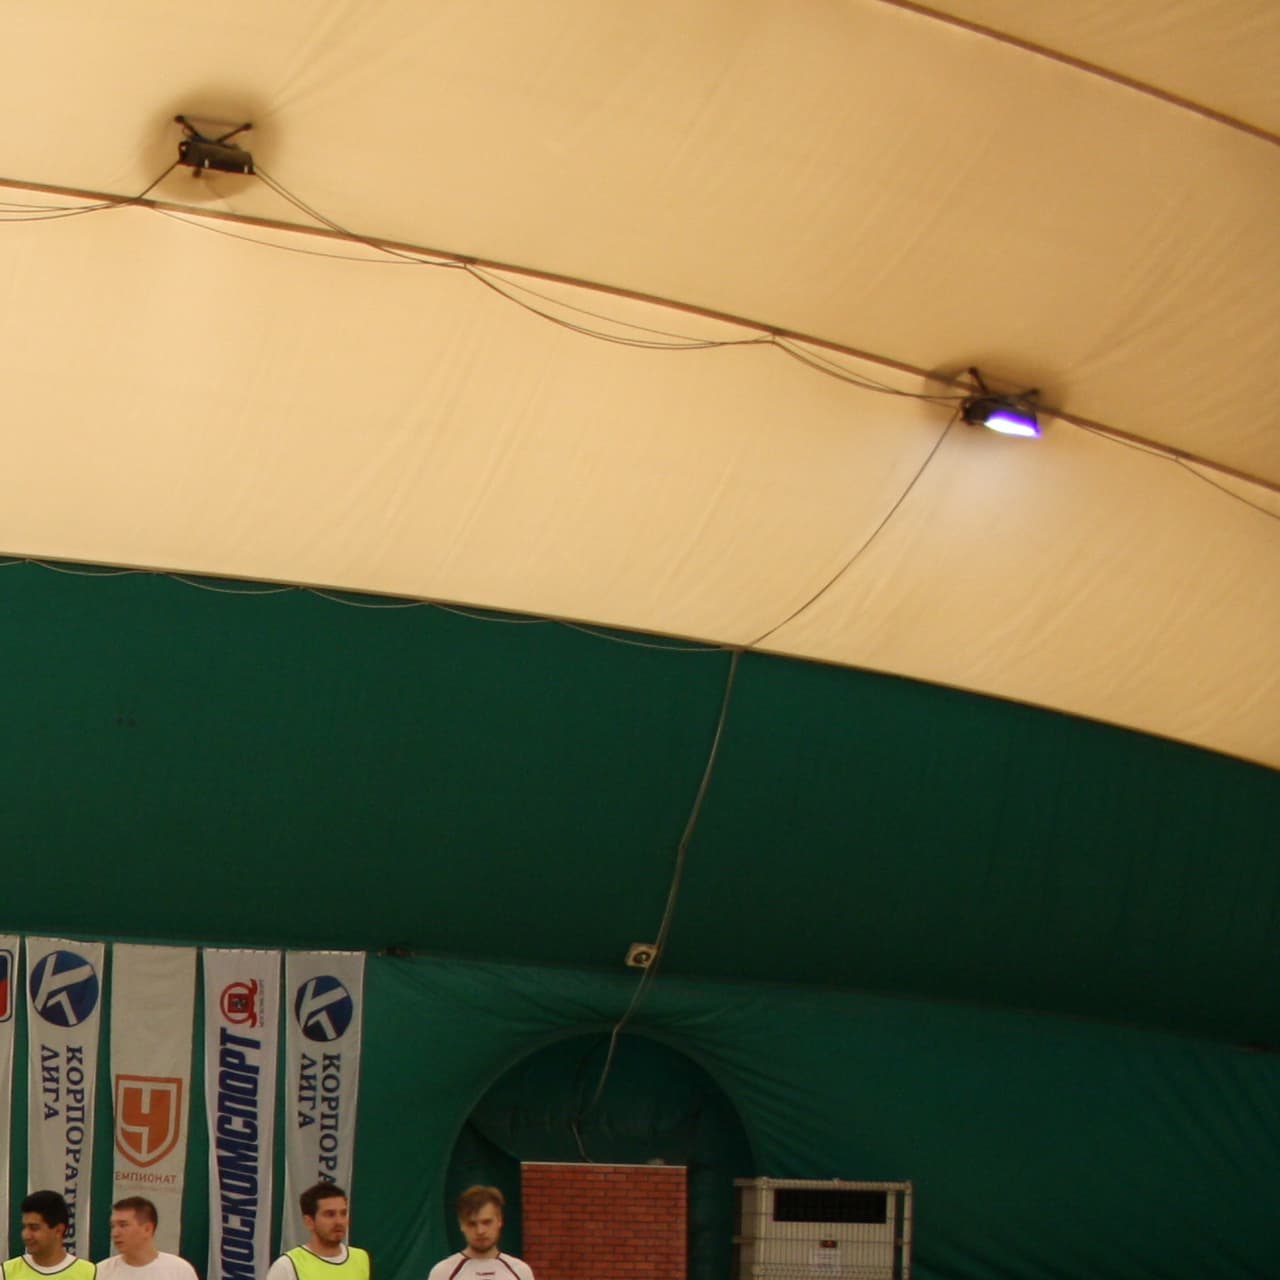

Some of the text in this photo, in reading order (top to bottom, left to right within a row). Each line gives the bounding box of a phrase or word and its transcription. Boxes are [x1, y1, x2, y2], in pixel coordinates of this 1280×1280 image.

[40, 1044, 60, 1121] ЛИГА
[298, 1053, 317, 1129] ЛИГА
[318, 1053, 341, 1185] КОРПОРА
[63, 1045, 85, 1256] КОРПОРАТИВН
[115, 1171, 176, 1184] ЕМПИОНАТ
